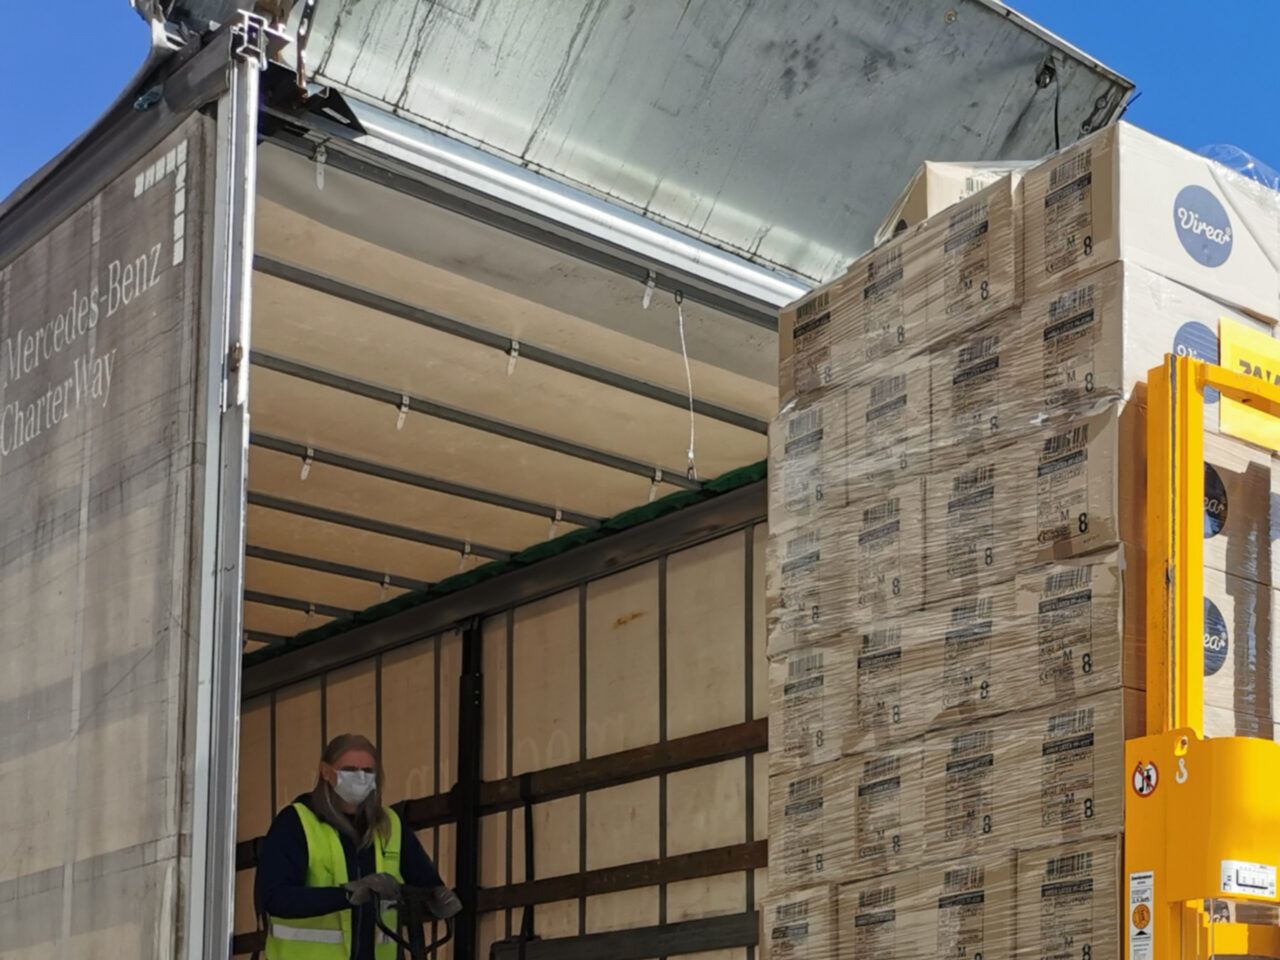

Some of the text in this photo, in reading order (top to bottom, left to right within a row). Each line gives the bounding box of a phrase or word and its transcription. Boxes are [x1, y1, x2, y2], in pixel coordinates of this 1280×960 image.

[1083, 236, 1092, 256] 8
[980, 281, 989, 300] 8
[4, 243, 161, 388] Mercedes-Benz
[896, 326, 905, 343] 8
[1084, 373, 1094, 393] 8
[0, 348, 117, 455] CharterWay
[816, 485, 823, 500] 8
[1079, 512, 1088, 533] 8
[984, 547, 993, 566] 8
[892, 578, 900, 595] 8
[1082, 653, 1091, 673] 8
[980, 681, 989, 699] 8
[892, 705, 900, 723] 8
[816, 730, 823, 747] 8
[1084, 798, 1093, 818] 8
[983, 815, 991, 833] 8
[892, 835, 900, 852] 8
[816, 853, 823, 870] 8
